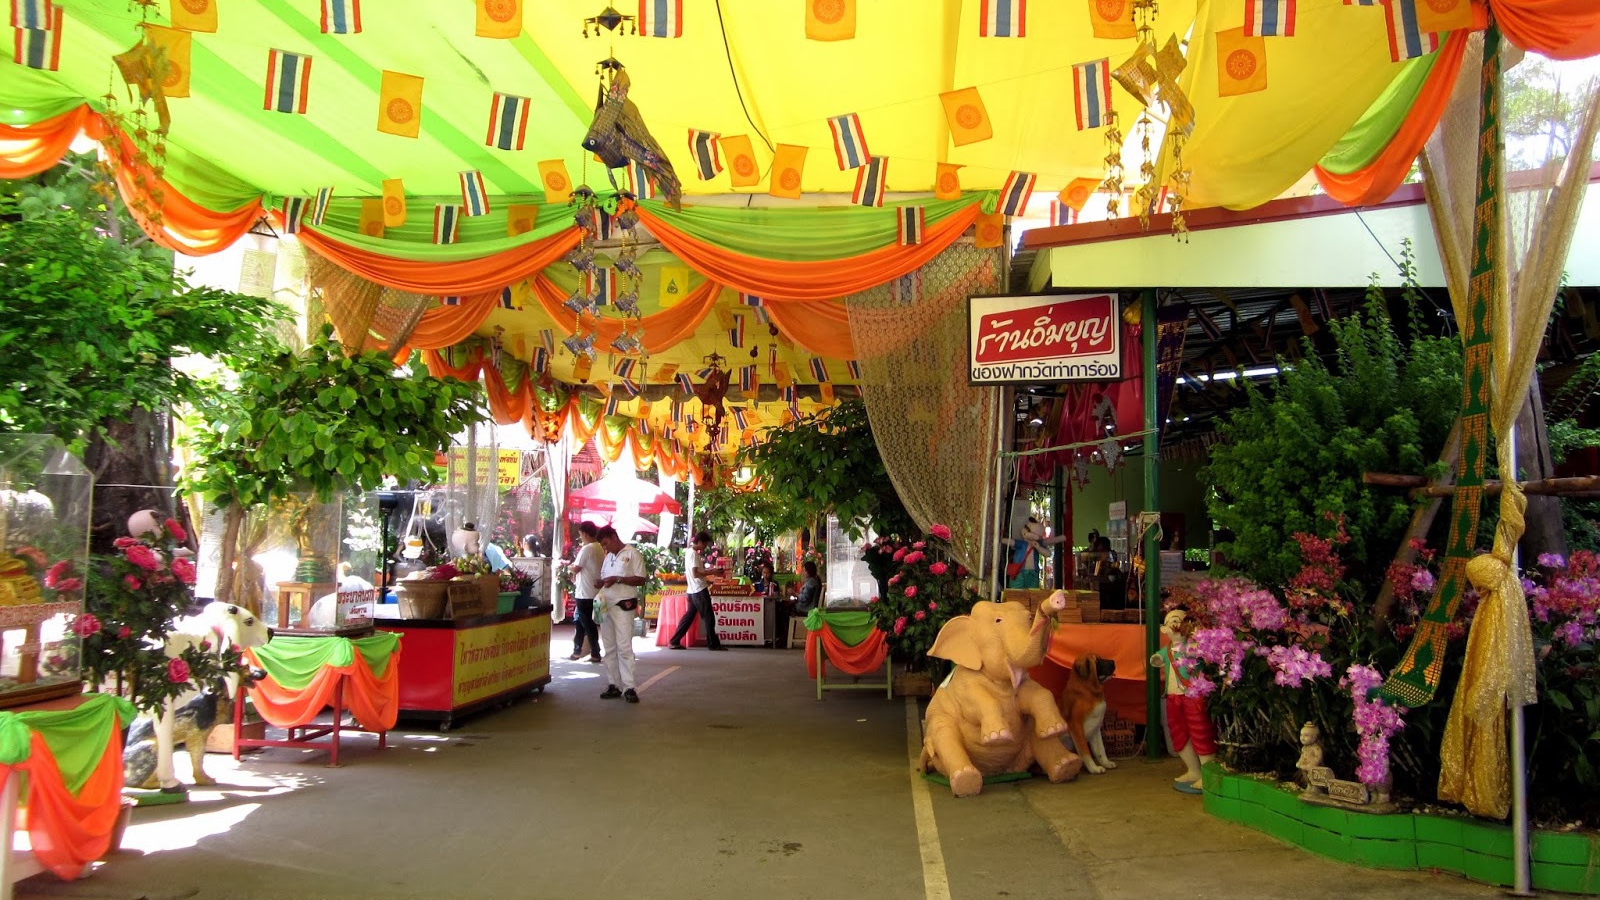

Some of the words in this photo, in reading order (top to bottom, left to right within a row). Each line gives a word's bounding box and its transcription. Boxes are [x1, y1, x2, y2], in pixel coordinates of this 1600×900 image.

[978, 306, 1110, 355] ร้านอิ่มบุญ
[972, 360, 1118, 379] ของฝากวัดท่าการ้อง
[717, 615, 755, 627] รับแลก
[716, 630, 757, 641] งินปลีก
